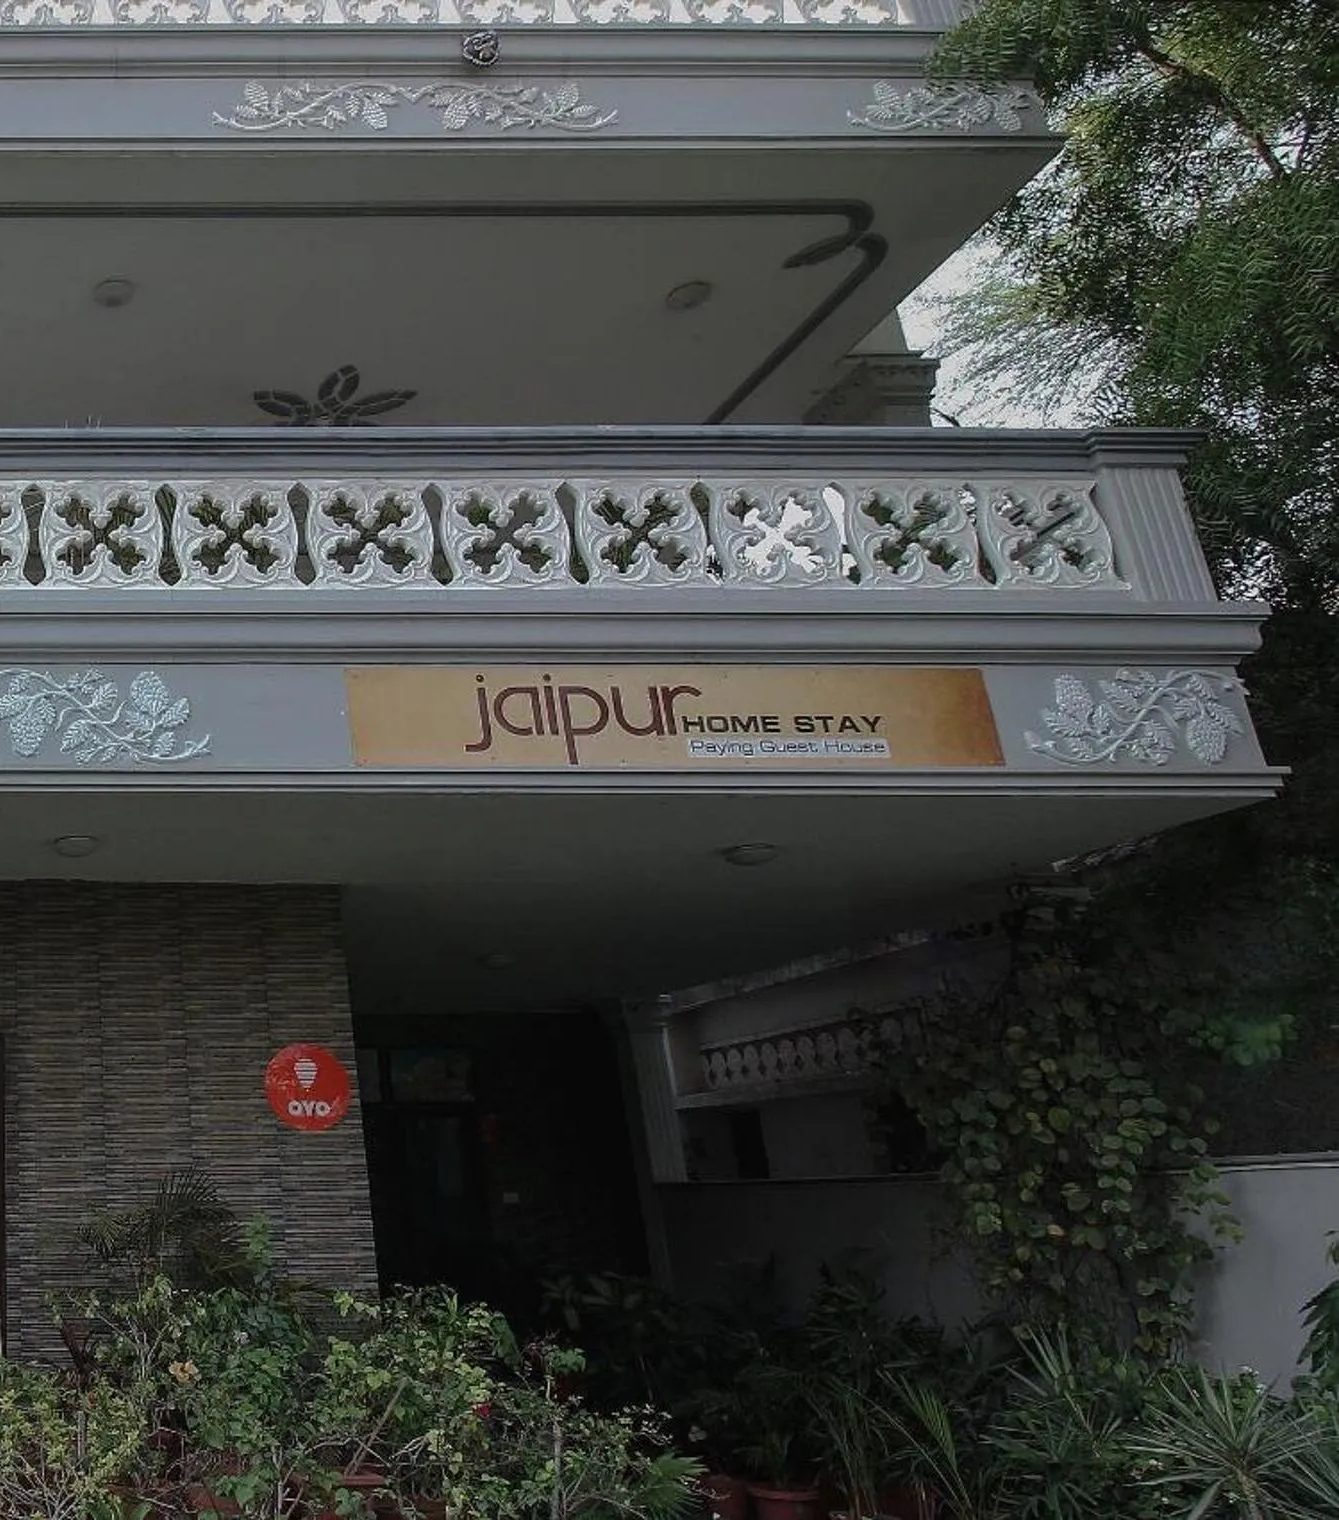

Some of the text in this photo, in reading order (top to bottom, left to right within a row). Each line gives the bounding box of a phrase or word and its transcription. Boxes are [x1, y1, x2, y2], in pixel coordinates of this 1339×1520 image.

[464, 673, 882, 765] jaipur HOME STAY
[690, 740, 886, 756] Paying Guest House
[288, 1100, 331, 1117] OYO
